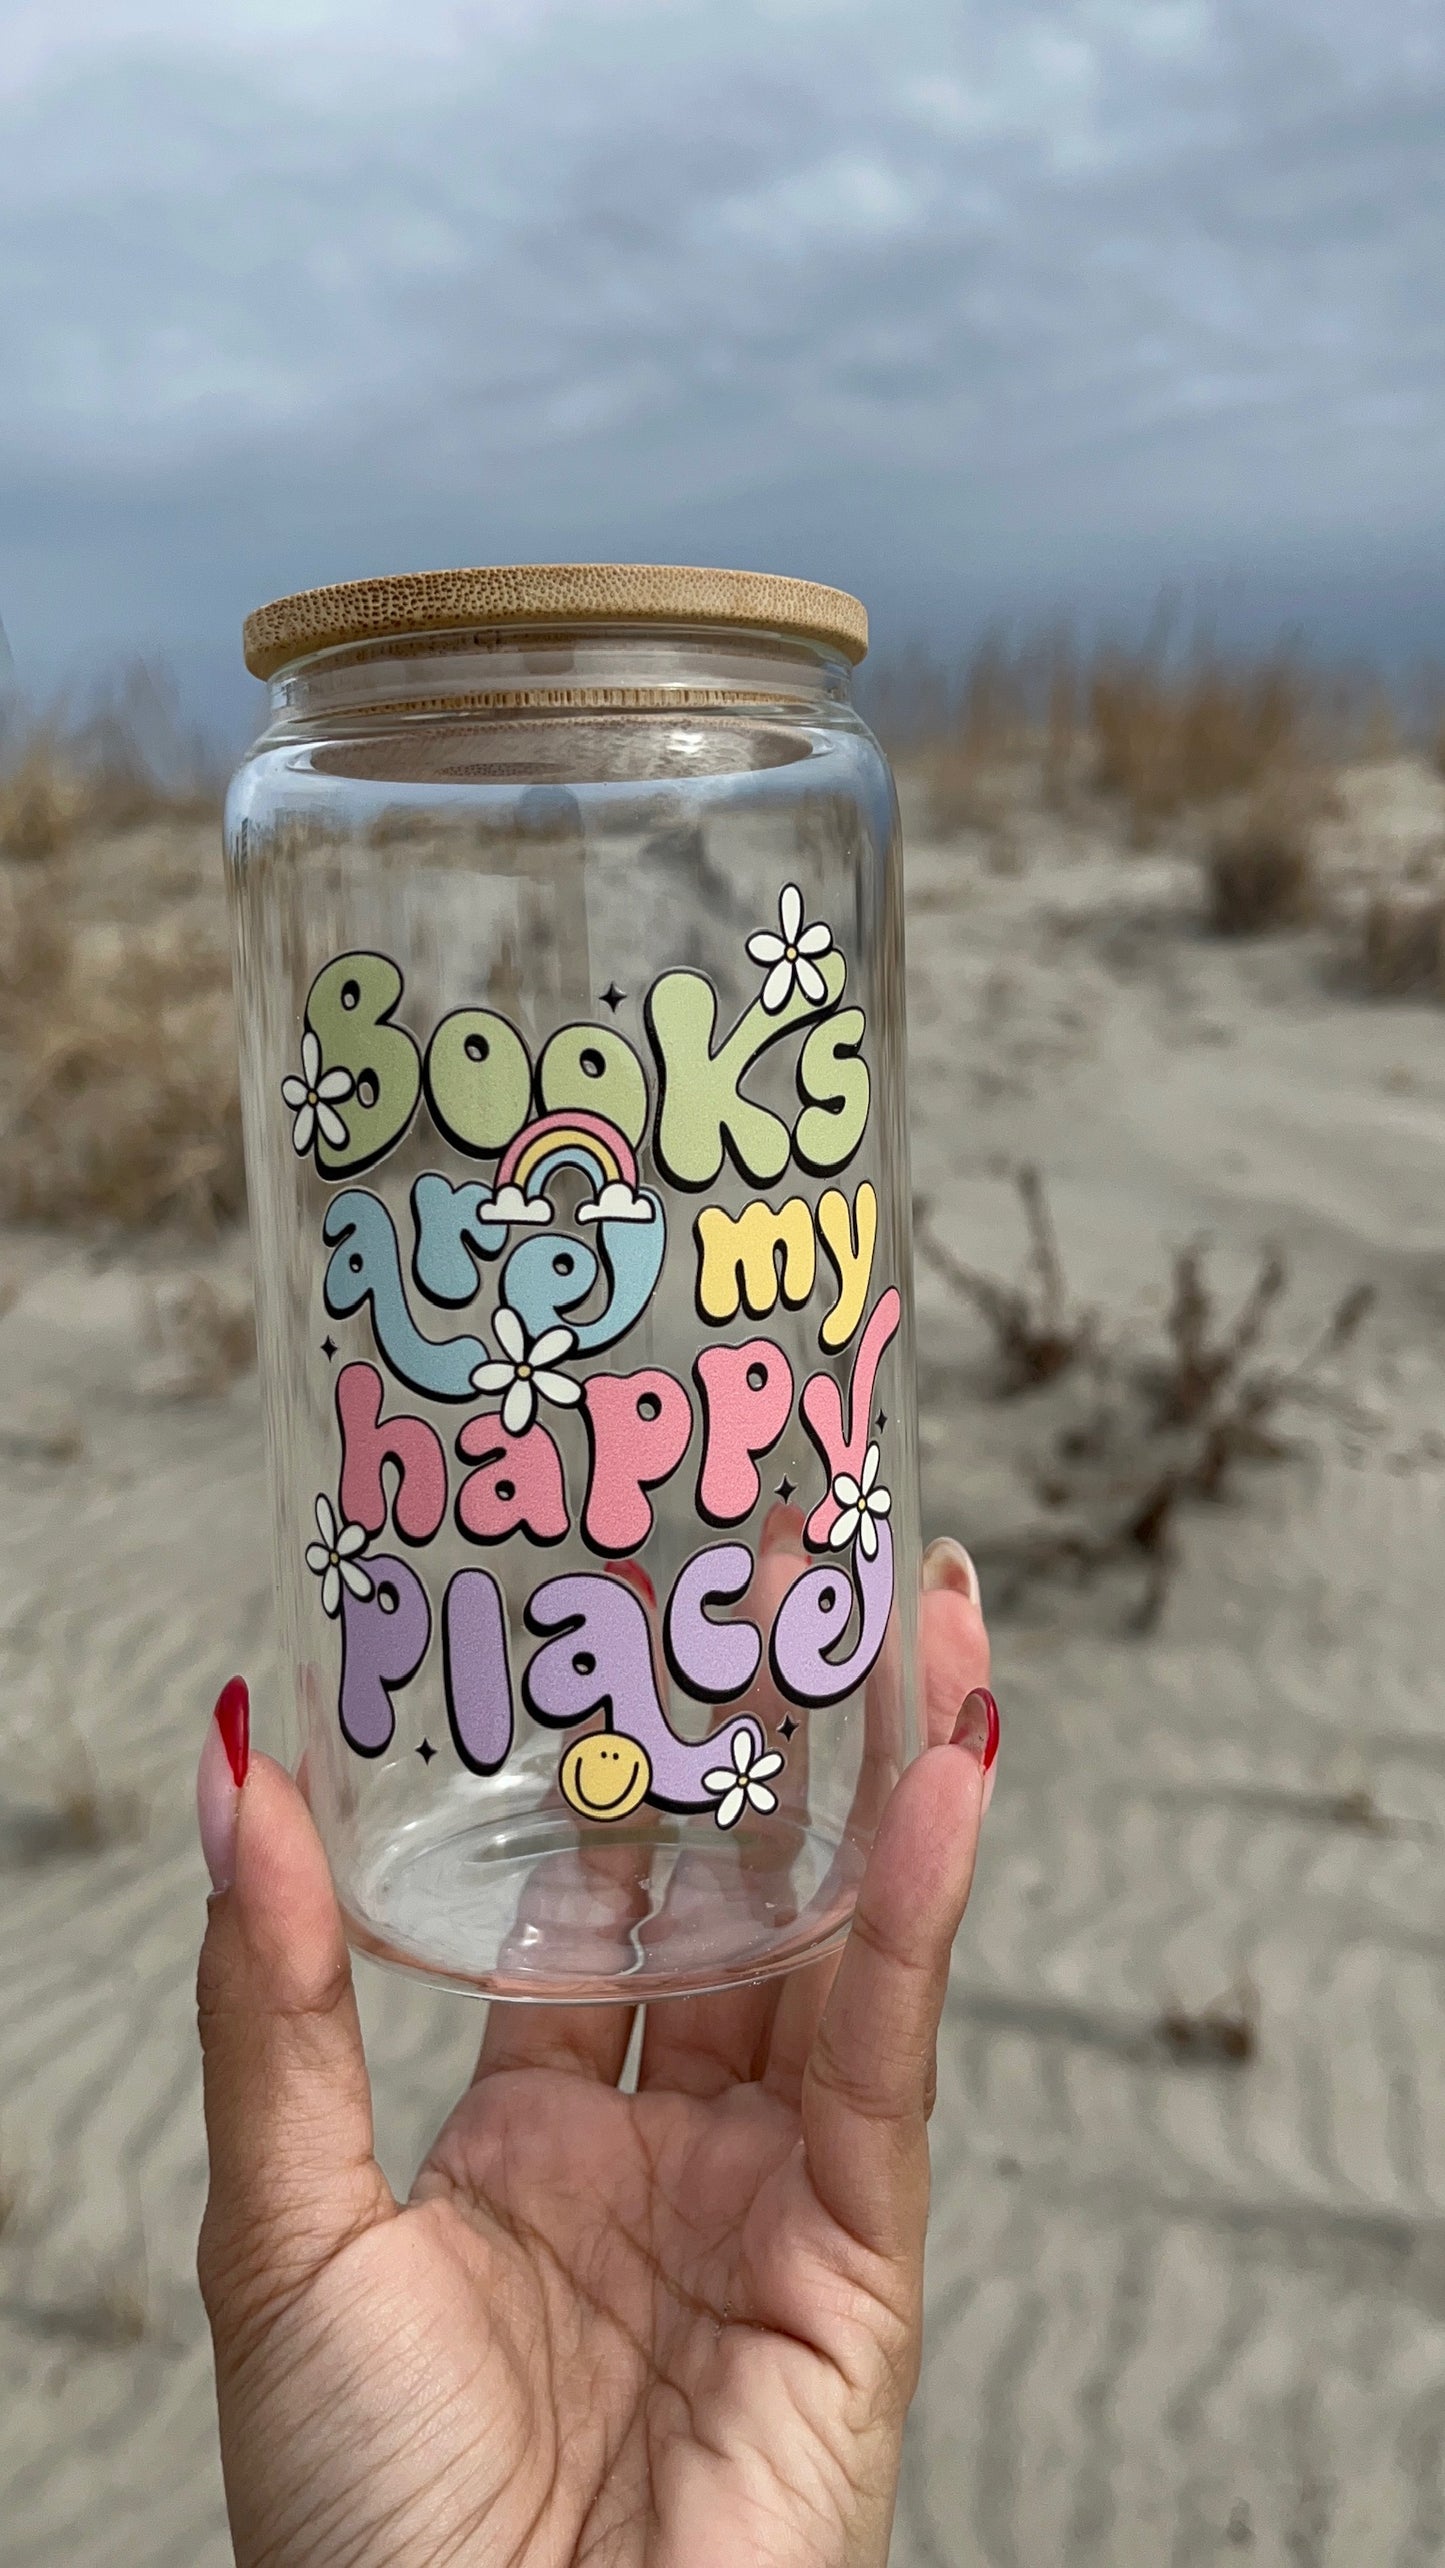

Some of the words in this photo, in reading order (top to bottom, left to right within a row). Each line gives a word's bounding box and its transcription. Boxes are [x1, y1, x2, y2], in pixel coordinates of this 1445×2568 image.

[324, 1172, 666, 1403] are
[694, 1181, 877, 1355] my
[336, 1287, 900, 1559] happy
